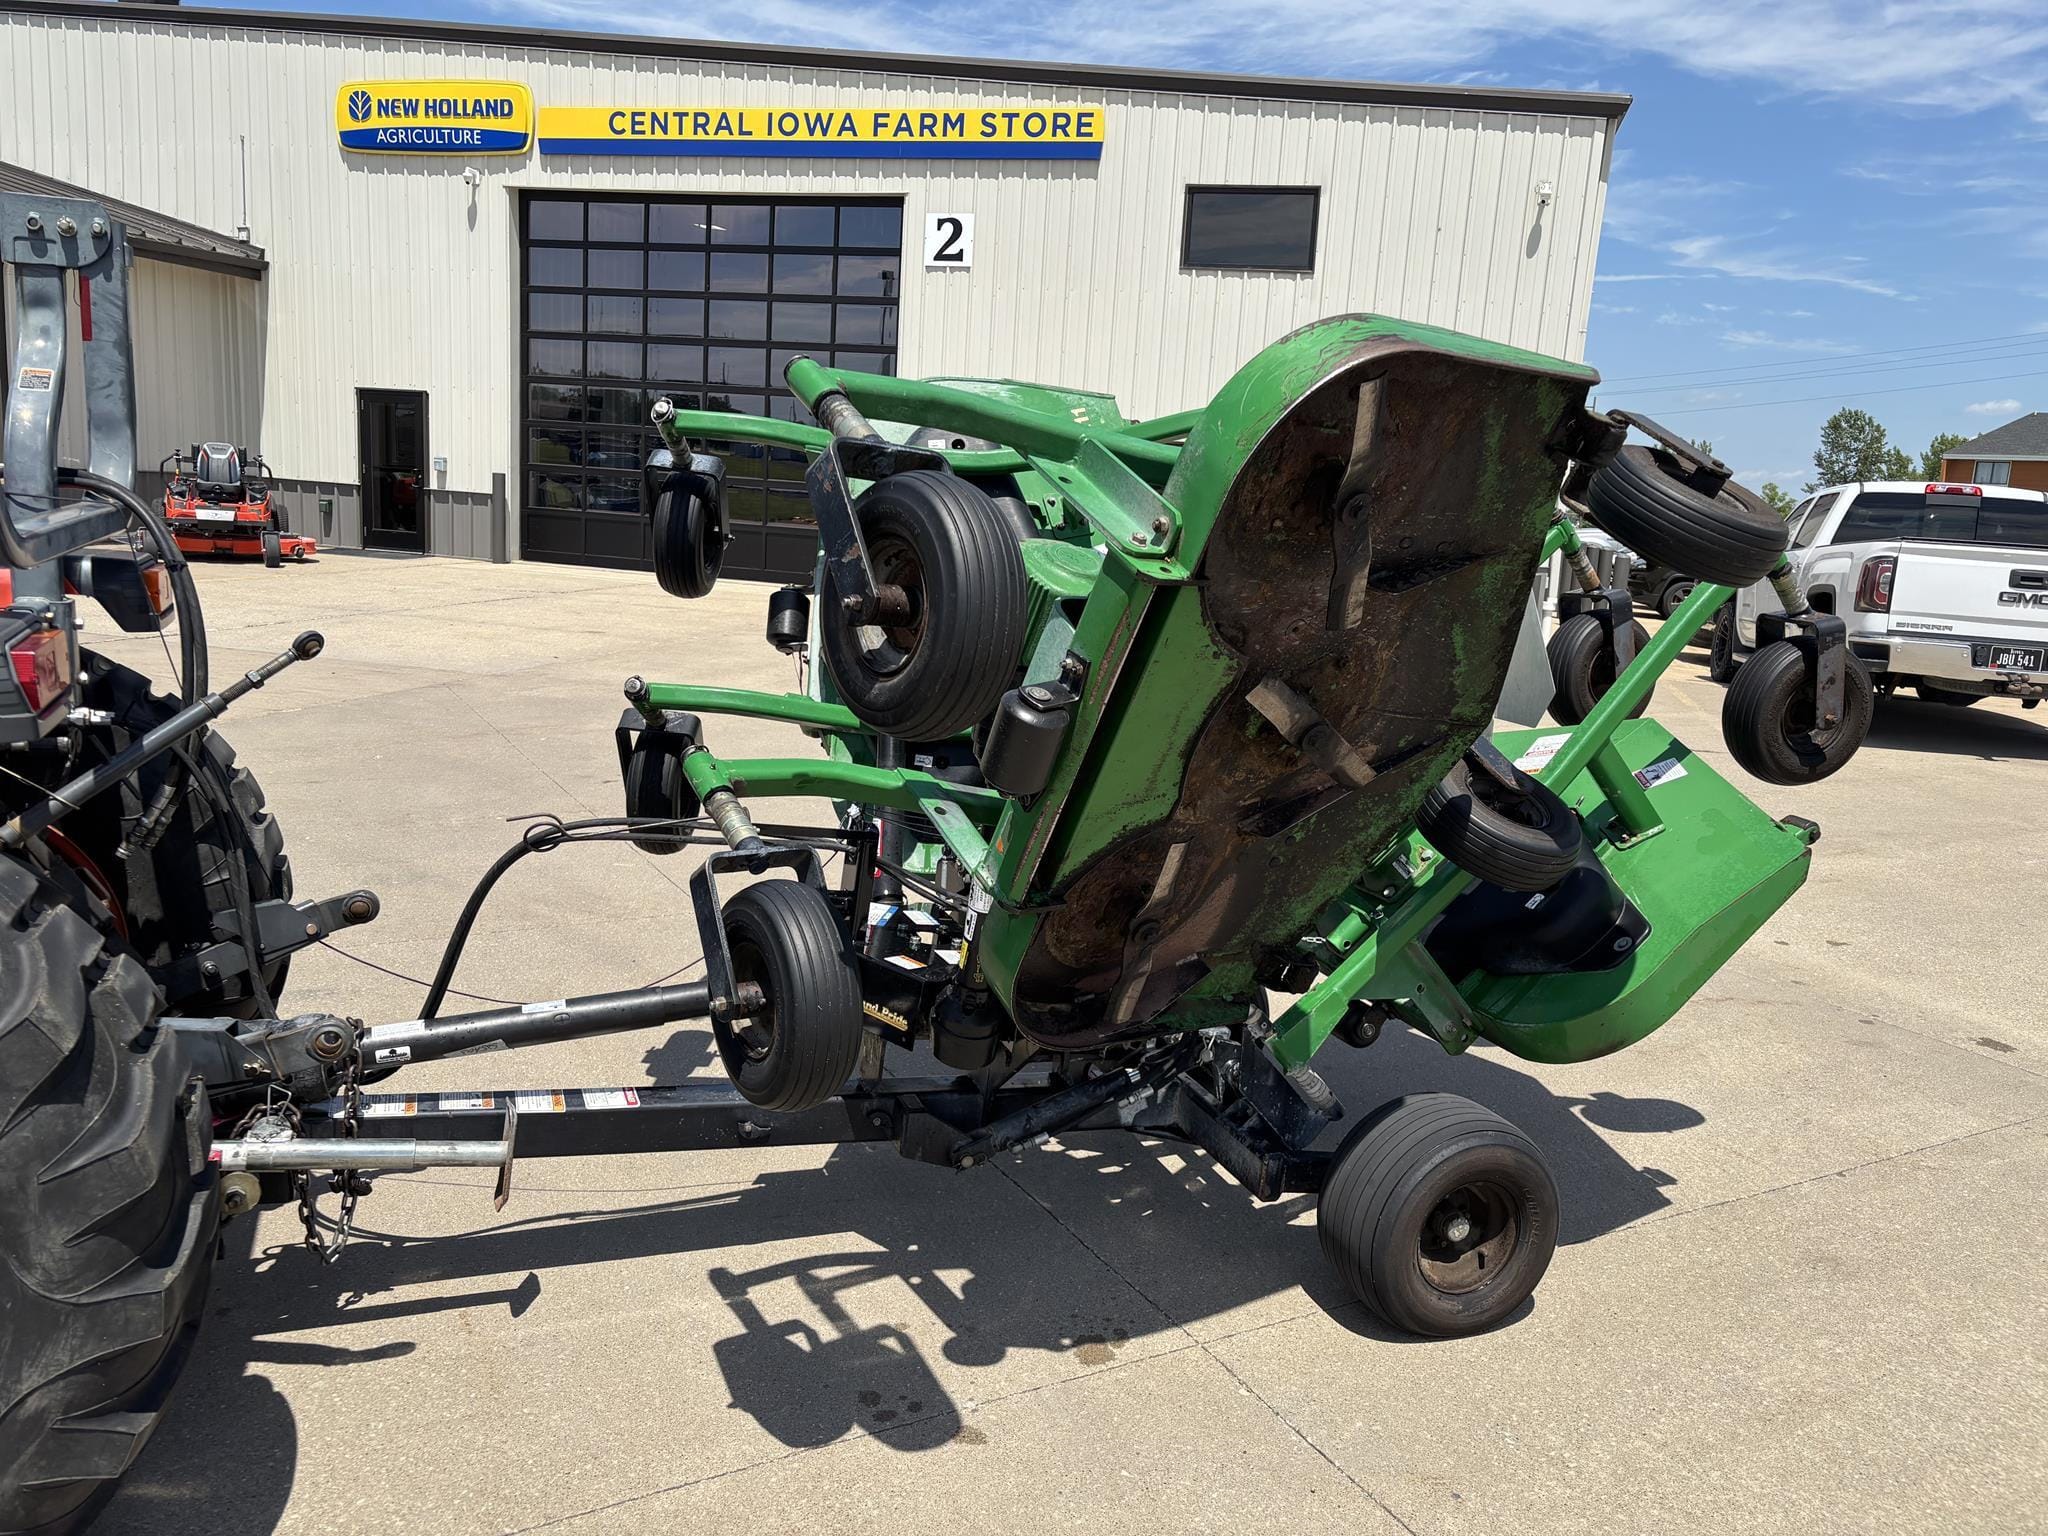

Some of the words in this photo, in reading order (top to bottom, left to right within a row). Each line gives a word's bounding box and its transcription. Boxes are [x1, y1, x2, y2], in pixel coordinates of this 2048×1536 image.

[376, 98, 419, 119] NEW
[424, 98, 514, 120] HOLLAND
[608, 110, 754, 137] CENTRAL
[767, 112, 858, 138] IOWA
[872, 112, 966, 138] FARM
[979, 112, 1095, 138] STORE
[376, 127, 482, 145] AGRICULTURE
[932, 217, 964, 262] 2
[1996, 653, 2016, 666] JBU
[2017, 654, 2035, 667] 541
